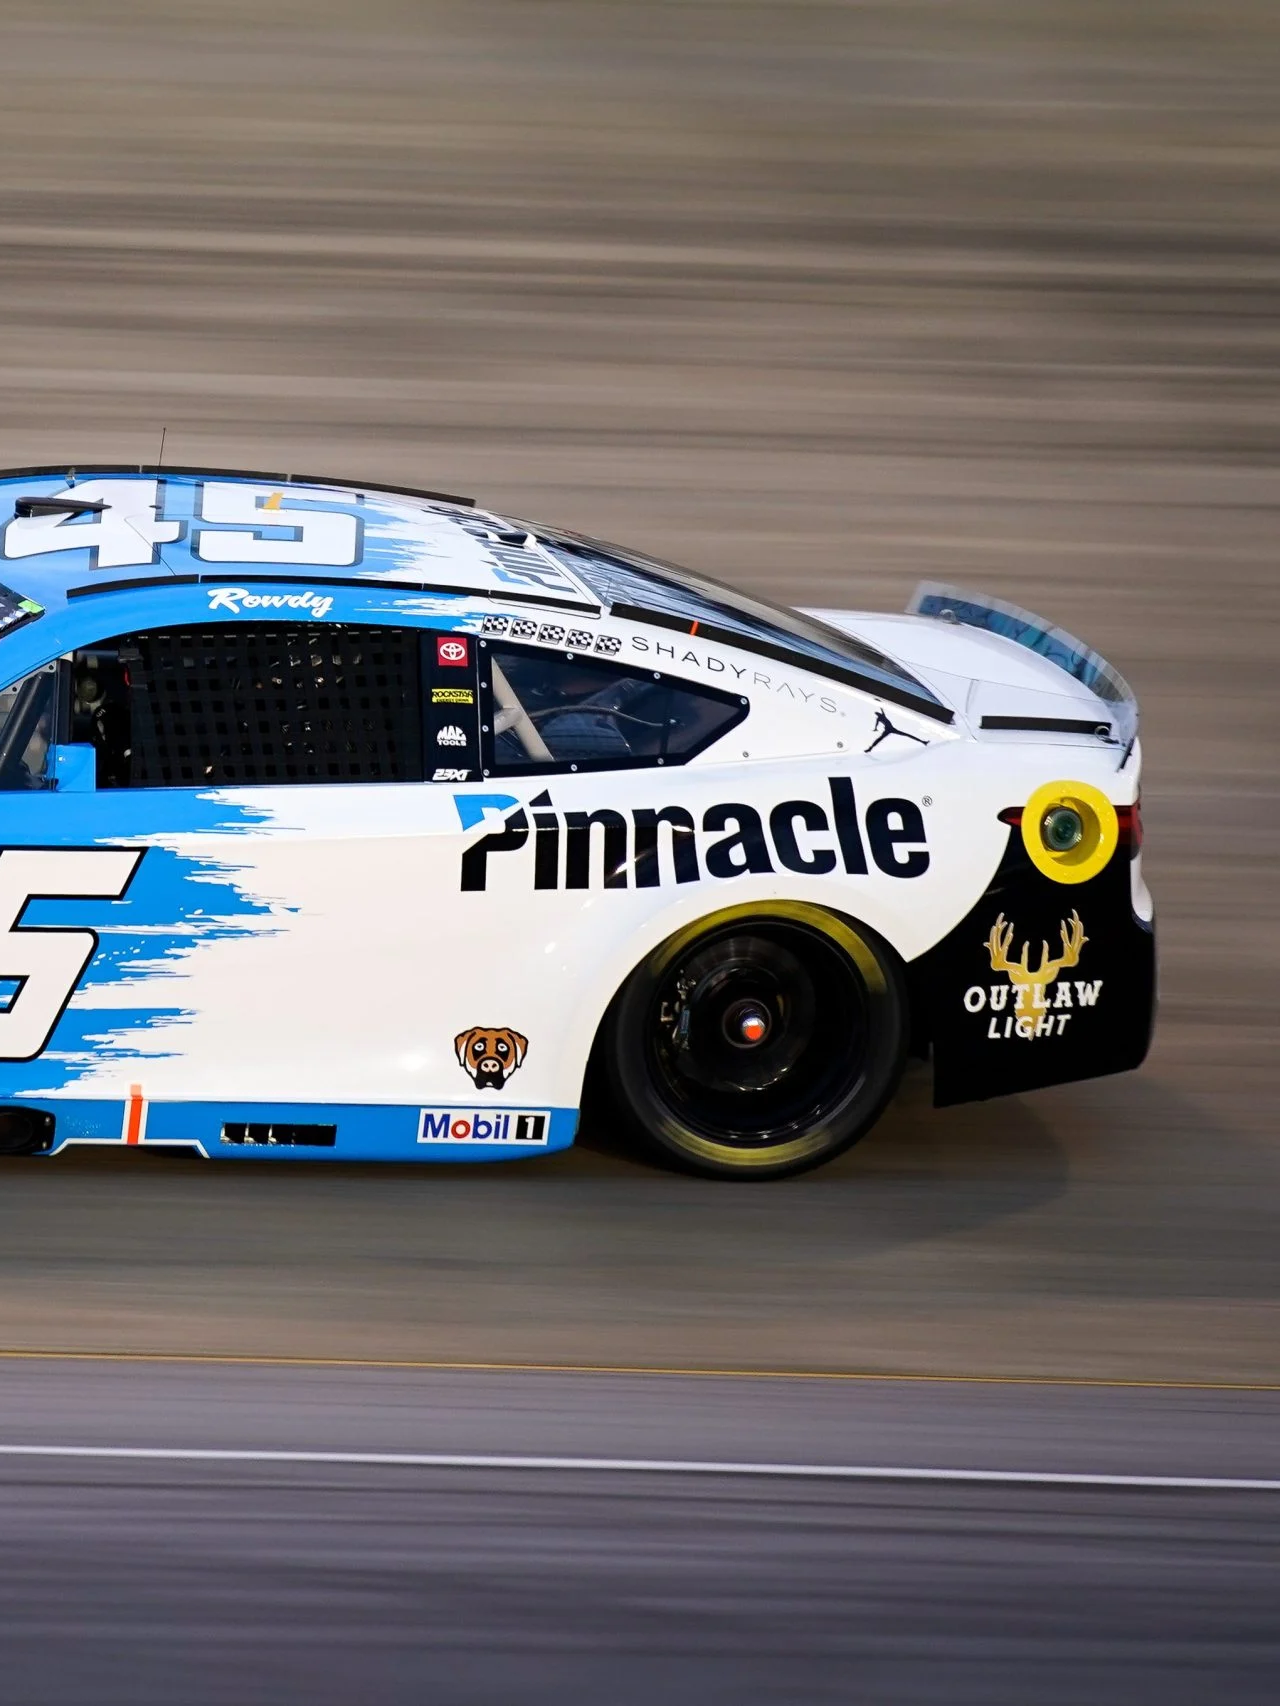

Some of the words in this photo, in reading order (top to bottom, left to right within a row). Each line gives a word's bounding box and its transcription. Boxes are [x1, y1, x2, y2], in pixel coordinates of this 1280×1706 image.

[207, 587, 333, 617] Rowdy
[437, 725, 466, 740] MAC
[439, 739, 467, 747] TOOLS
[453, 776, 931, 892] Pinnacle
[963, 980, 1103, 1013] OUTLAW
[987, 1014, 1071, 1039] LIGHT
[422, 1113, 510, 1140] Mobil
